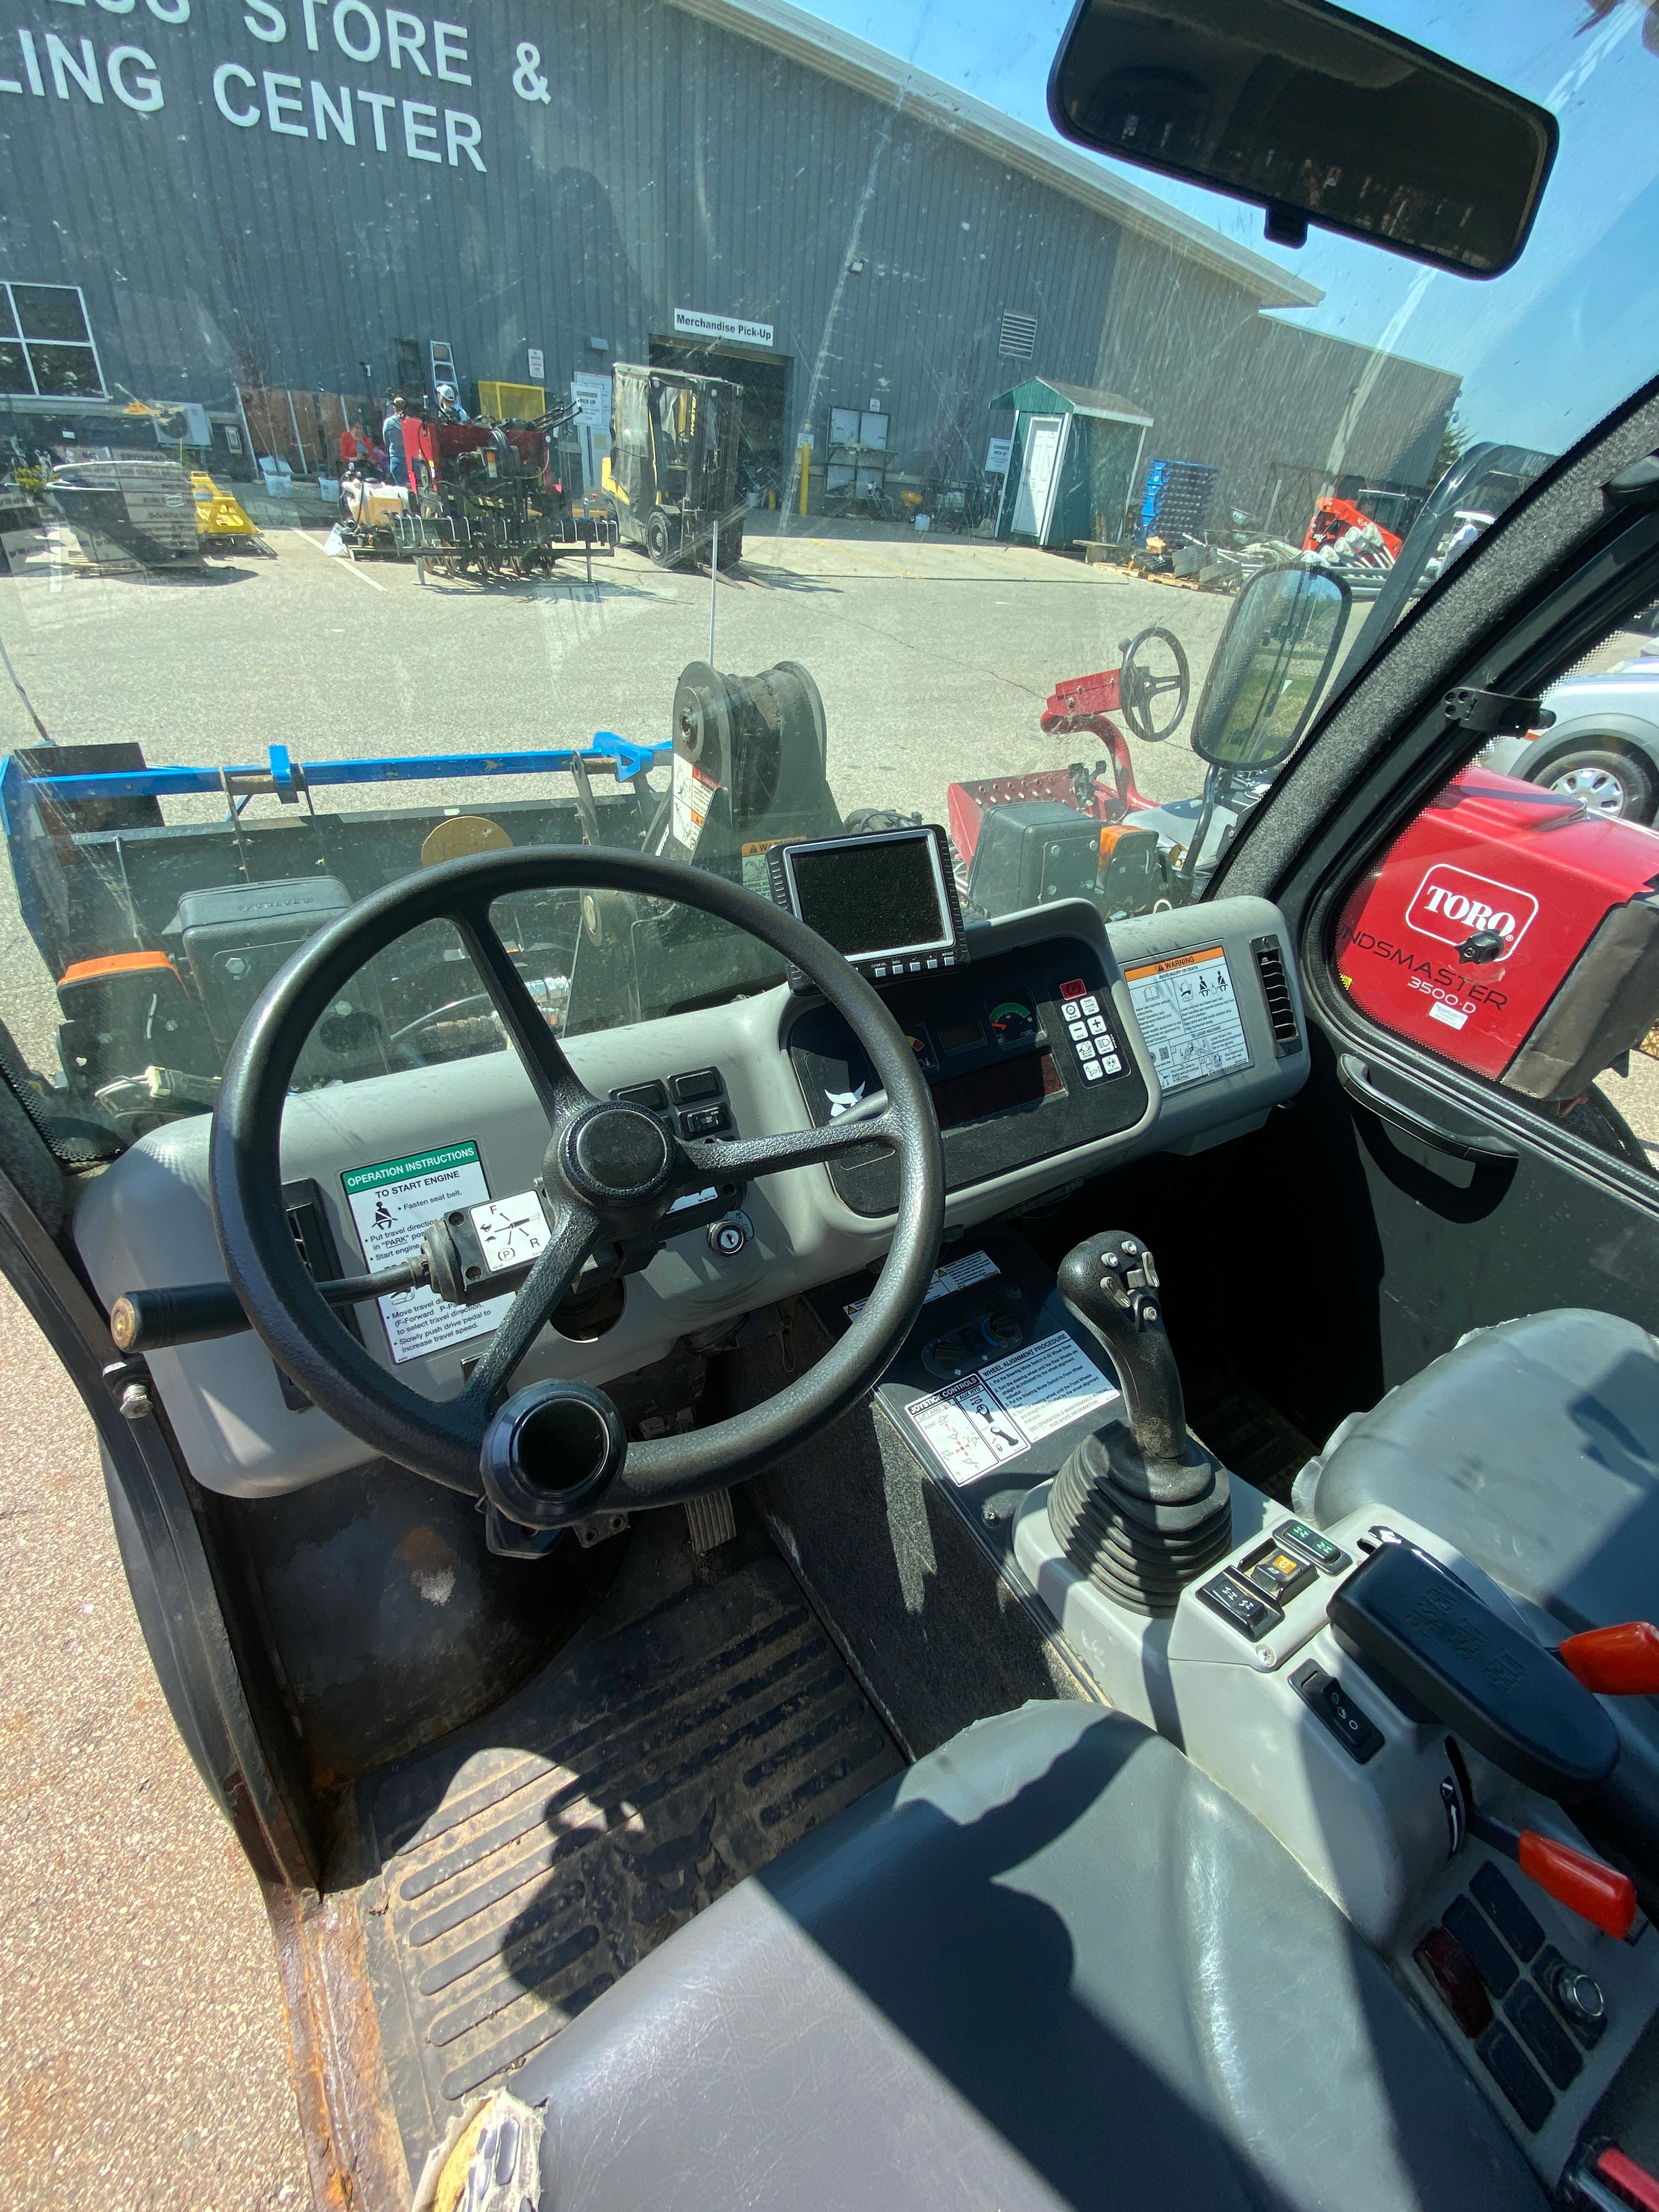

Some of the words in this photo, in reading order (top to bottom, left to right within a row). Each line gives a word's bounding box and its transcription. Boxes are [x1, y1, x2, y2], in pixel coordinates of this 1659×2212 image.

[244, 0, 472, 86] STORE
[513, 42, 551, 104] &
[0, 29, 165, 112] ING
[213, 63, 487, 172] CENTER
[676, 314, 736, 334] Merchandise
[738, 324, 771, 341] Pick-Up
[1424, 885, 1516, 937] TORO
[1164, 955, 1195, 970] WARNING
[347, 1164, 407, 1187] OPERATION
[404, 1146, 475, 1172] INSTRUCTIONS
[375, 1188, 390, 1199] TO
[391, 1180, 423, 1194] START
[424, 1170, 460, 1186] ENGINE
[403, 1198, 428, 1210] Fasten
[429, 1194, 445, 1203] seat
[445, 1189, 462, 1198] belt.
[489, 1205, 499, 1214] F
[369, 1233, 384, 1243] Put
[384, 1227, 406, 1238] travel
[529, 1237, 540, 1248] R
[375, 1250, 394, 1260] Start
[394, 1243, 420, 1255] engine
[391, 1307, 413, 1319] Move
[413, 1300, 435, 1312] travel
[393, 1309, 435, 1327] (F-Forward
[439, 1301, 458, 1312] P-Pa
[405, 1319, 428, 1332] select
[429, 1312, 450, 1324] travel
[399, 1333, 424, 1345] Slowly
[424, 1325, 444, 1338] push
[443, 1319, 462, 1330] drive
[462, 1312, 483, 1324] pedal
[401, 1338, 433, 1353] increase
[433, 1330, 454, 1342] travel
[454, 1322, 479, 1335] speed.
[982, 1364, 1003, 1377] WHEEL
[1001, 1348, 1036, 1368] ALIGNMENT
[1032, 1333, 1068, 1352] PROCEDURE
[1012, 1374, 1028, 1384] steering
[1059, 1352, 1073, 1360] Wheels
[1001, 1386, 1017, 1396] straight
[1019, 1375, 1037, 1386] indicated
[1057, 1357, 1075, 1368] alignment
[1005, 1368, 1022, 1378] Steering
[1021, 1388, 1038, 1399] Steering
[1036, 1383, 1048, 1391] Mode
[1071, 1364, 1084, 1373] Wheel
[909, 1393, 943, 1414] JOYSTICK
[941, 1376, 978, 1398] CONTROLS
[958, 1391, 970, 1400] AUX
[969, 1386, 981, 1395] HYD
[1026, 1406, 1041, 1417] straight
[1043, 1395, 1062, 1406] indicated
[1071, 1384, 1083, 1392] wheel
[1081, 1375, 1099, 1387] alignment
[1030, 1397, 1046, 1407] steering
[1045, 1391, 1057, 1400] wheel
[1078, 1373, 1092, 1381] Wheels
[918, 1412, 930, 1420] LIFT
[929, 1406, 941, 1414] AND
[1028, 1424, 1039, 1432] SEE
[1037, 1412, 1062, 1427] OPERATION
[1063, 1395, 1093, 1413] MAINTENANCE
[1091, 1386, 1108, 1397] MANUAL
[1049, 1420, 1059, 1428] FOR
[1057, 1413, 1072, 1423] MORE
[1070, 1399, 1099, 1416] INFORMATION
[923, 1421, 936, 1430] FLOAT
[1406, 1584, 1458, 1637] FASTEN
[1447, 1617, 1490, 1663] SEAT
[1483, 1648, 1526, 1696] BELT
